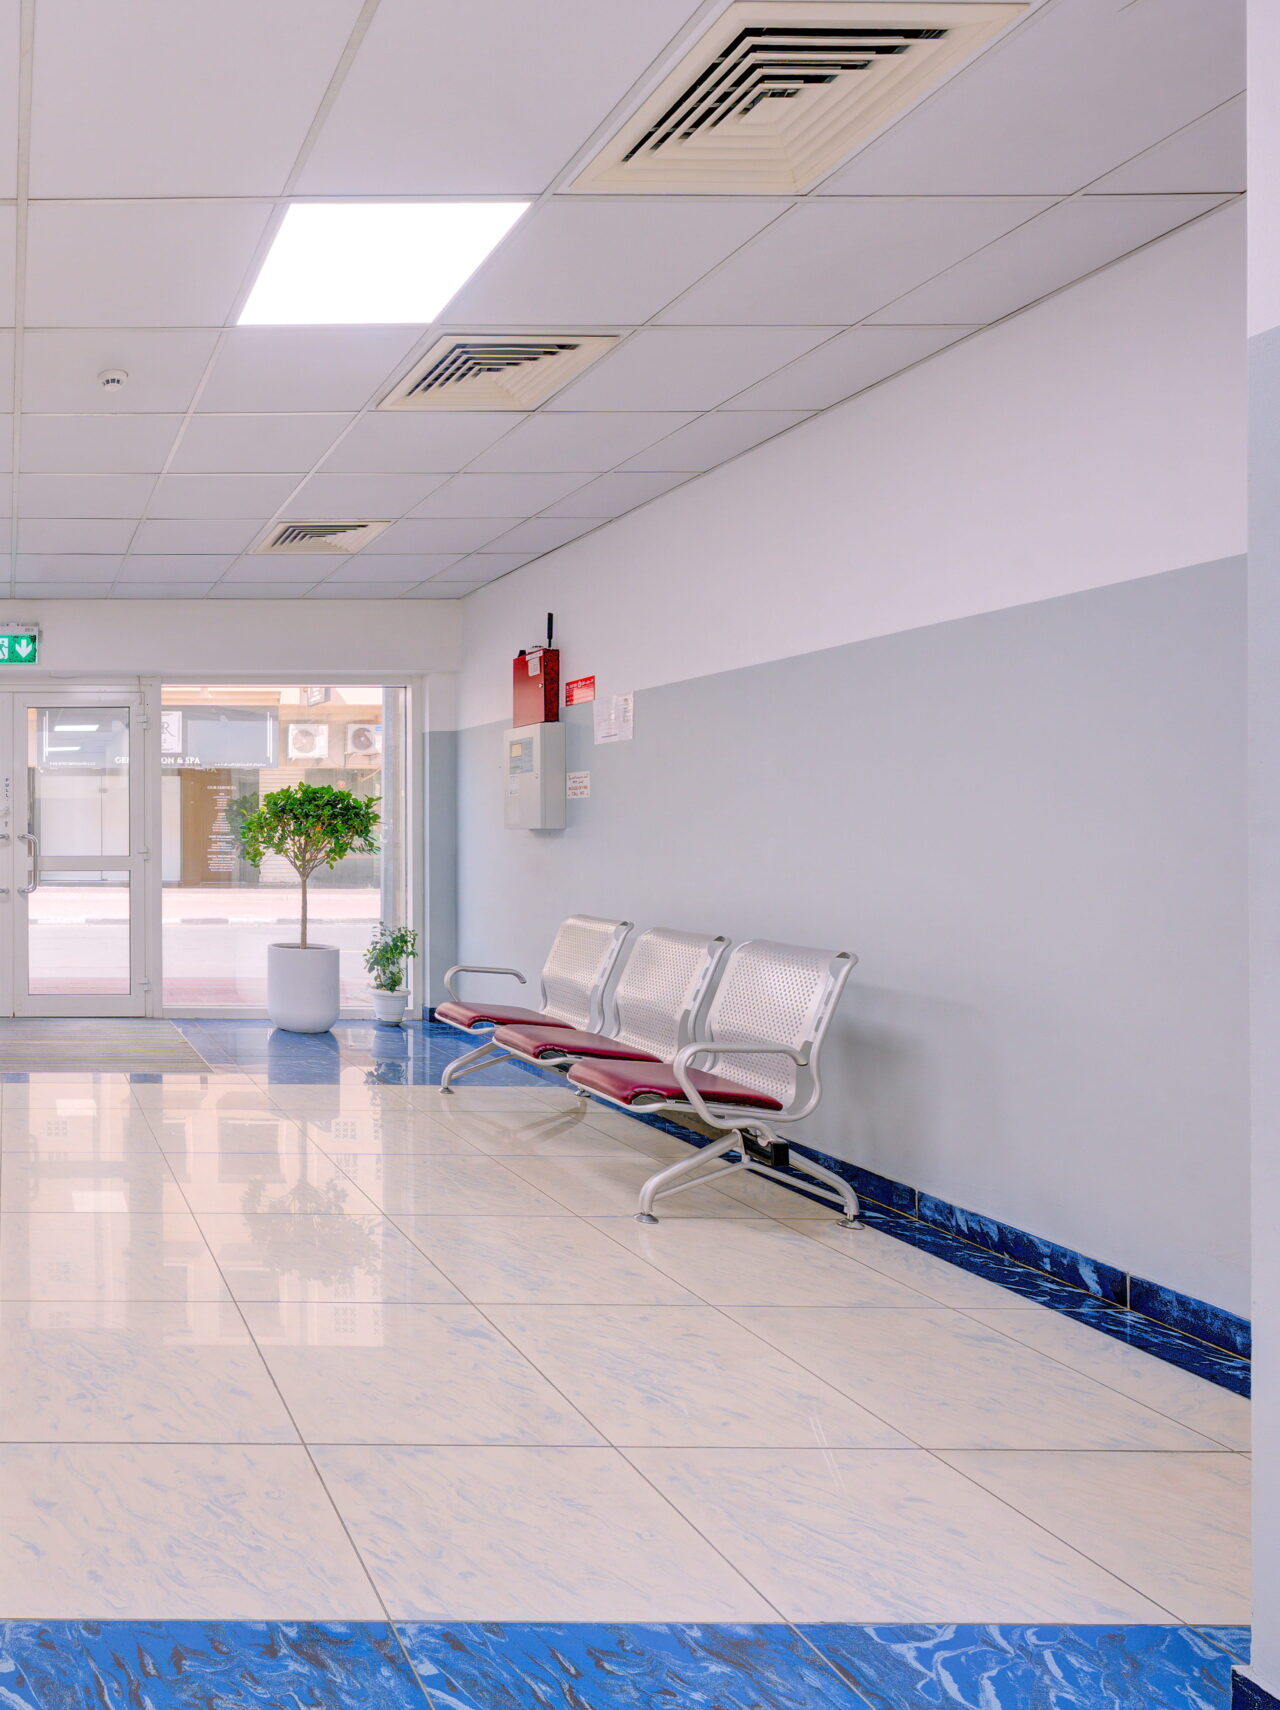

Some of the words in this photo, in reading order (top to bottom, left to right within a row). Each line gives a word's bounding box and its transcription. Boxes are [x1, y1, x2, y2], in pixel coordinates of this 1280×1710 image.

[161, 756, 175, 764] ON
[176, 756, 183, 764] &
[185, 756, 201, 764] SPA
